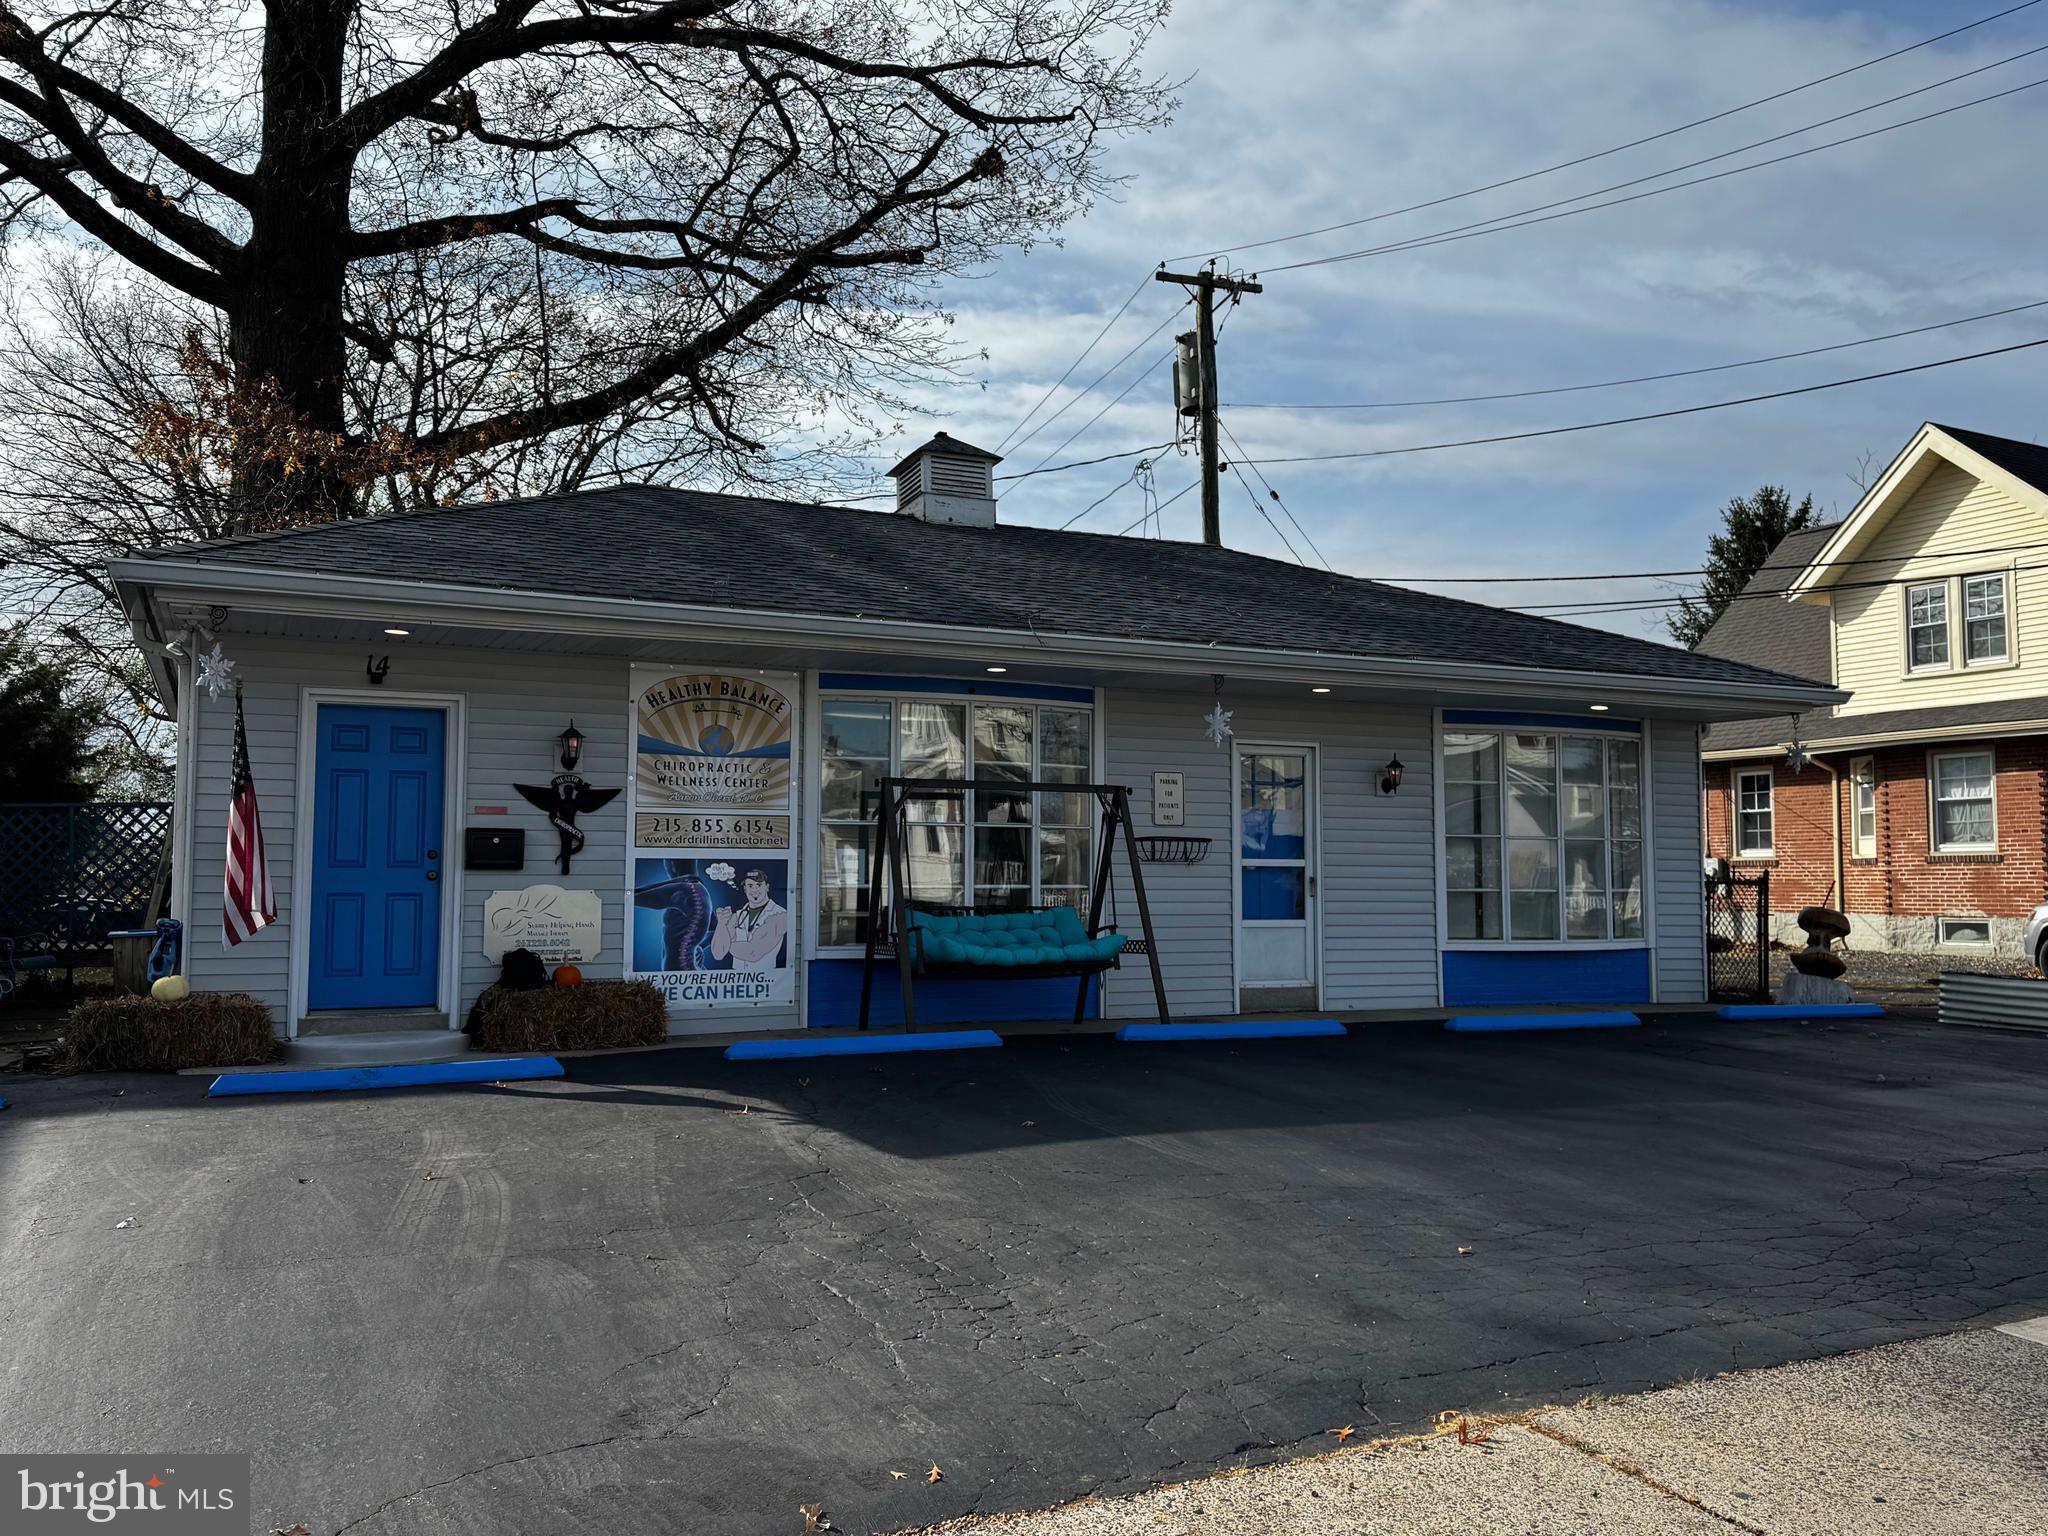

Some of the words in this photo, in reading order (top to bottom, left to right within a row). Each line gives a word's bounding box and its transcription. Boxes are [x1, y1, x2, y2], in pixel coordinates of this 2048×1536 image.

[366, 654, 390, 676] 14
[645, 681, 712, 709] HEALTHY
[720, 681, 786, 714] BALANCE
[654, 759, 752, 773] CHIROPRACTIC
[758, 762, 771, 774] &
[555, 775, 579, 785] HEALTH
[656, 774, 718, 787] WELLNESS
[724, 777, 769, 788] CENTER
[653, 818, 774, 834] 215.855.6154
[643, 834, 784, 846] www.drdrillinstructor.net
[661, 973, 707, 986] YOU'RE
[709, 971, 775, 985] HURTING...
[682, 986, 718, 1000] CAN
[723, 984, 770, 999] HELP!
